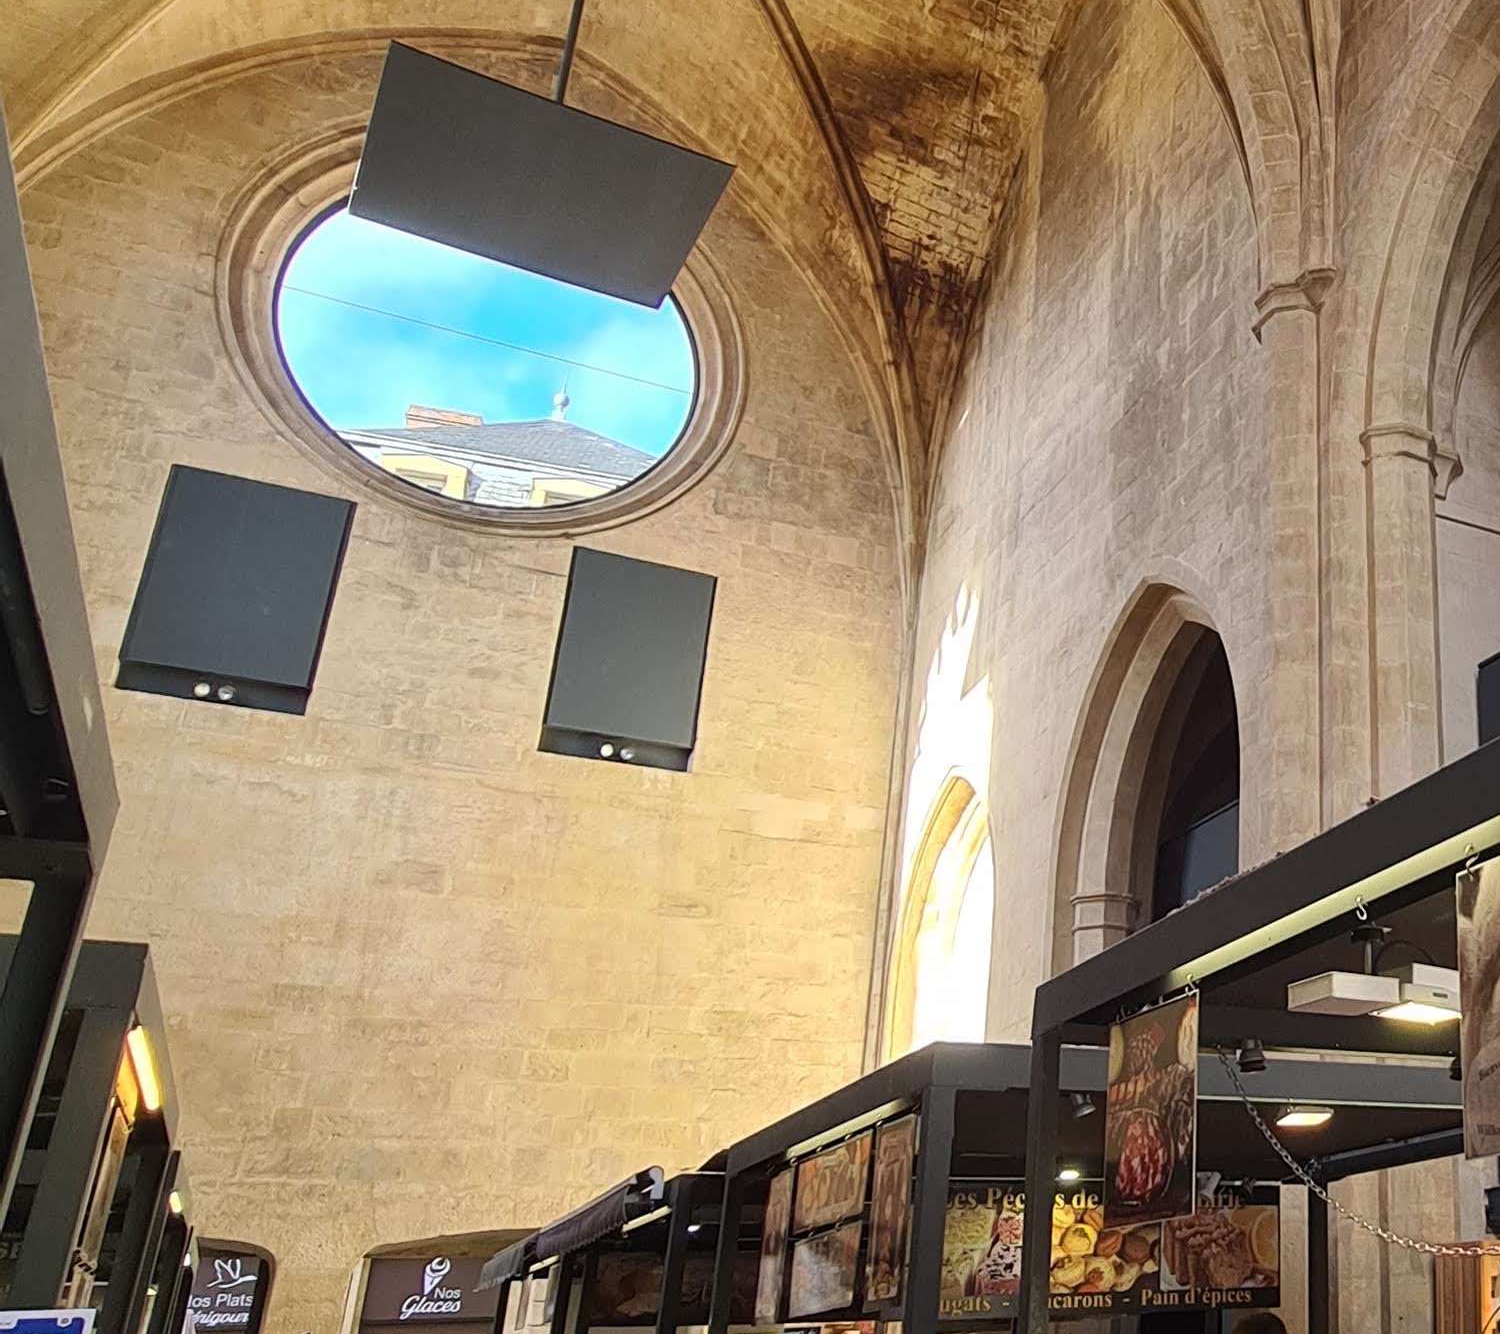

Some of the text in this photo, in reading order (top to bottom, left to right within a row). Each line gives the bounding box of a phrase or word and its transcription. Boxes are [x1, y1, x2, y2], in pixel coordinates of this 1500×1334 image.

[946, 1191, 978, 1209] es
[1071, 1188, 1099, 1209] de
[215, 1292, 255, 1308] Plats
[434, 1286, 461, 1300] Nos
[939, 1297, 991, 1314] ugats
[1047, 1293, 1113, 1310] carons
[1140, 1288, 1180, 1307] Pain
[399, 1295, 462, 1320] Glaces
